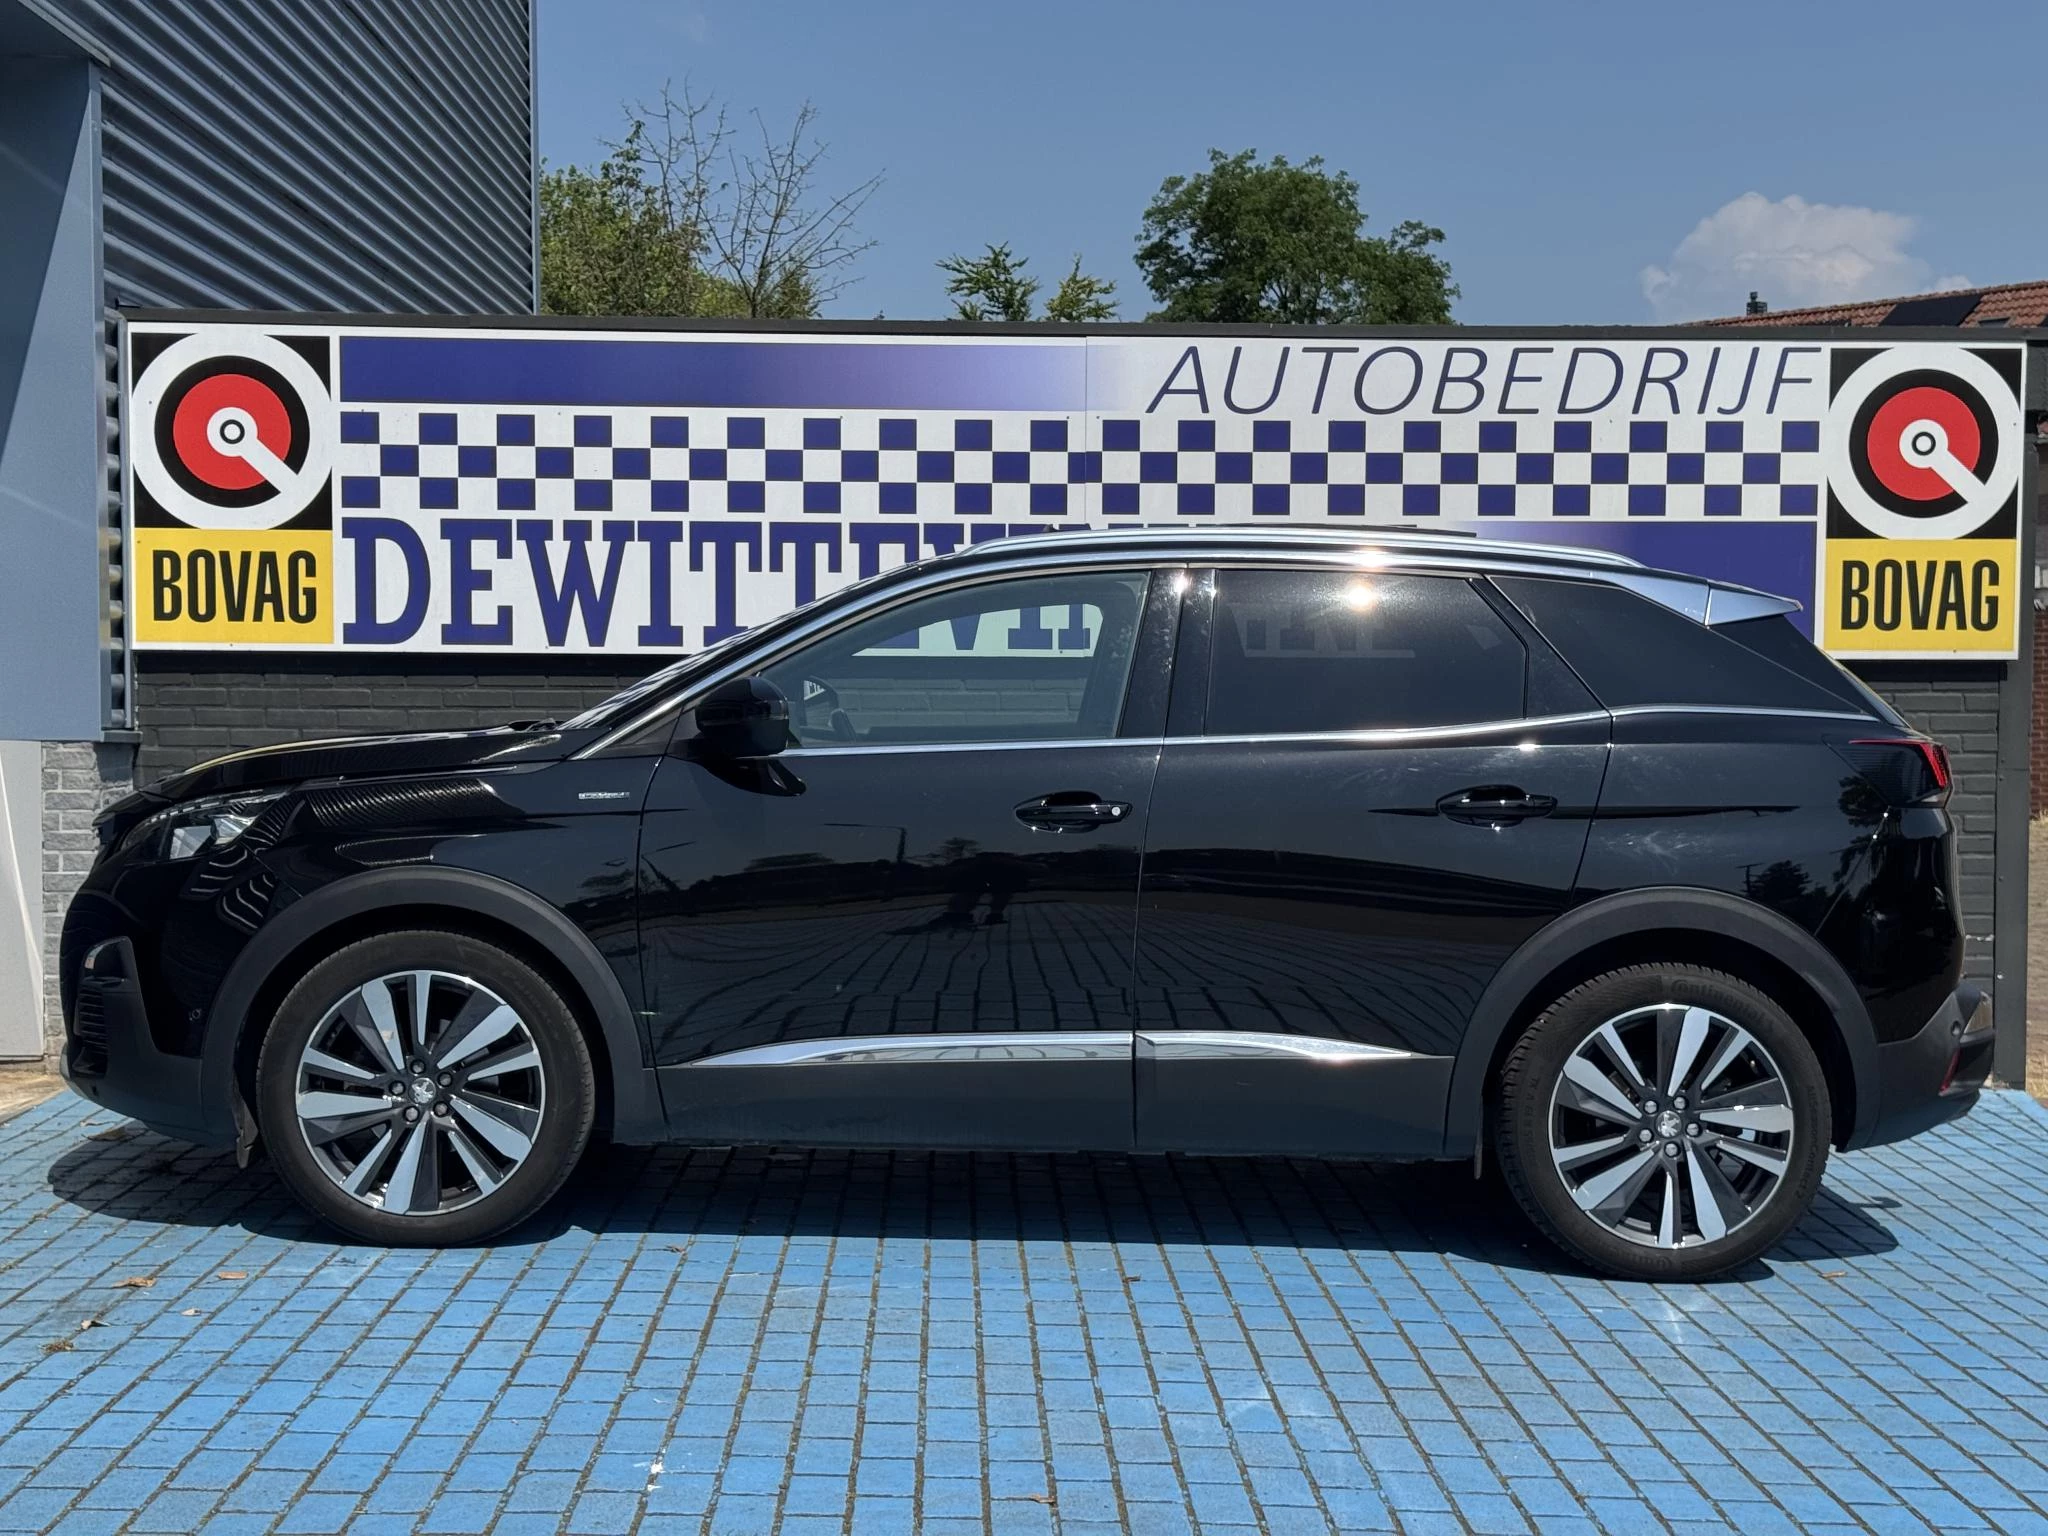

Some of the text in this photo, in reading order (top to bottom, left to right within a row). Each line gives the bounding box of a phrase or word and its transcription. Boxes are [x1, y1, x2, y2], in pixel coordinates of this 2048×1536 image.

[1145, 345, 1822, 415] AUTOBEDRIJF
[153, 549, 317, 624] BOVAG
[1840, 558, 2000, 632] BOVAG
